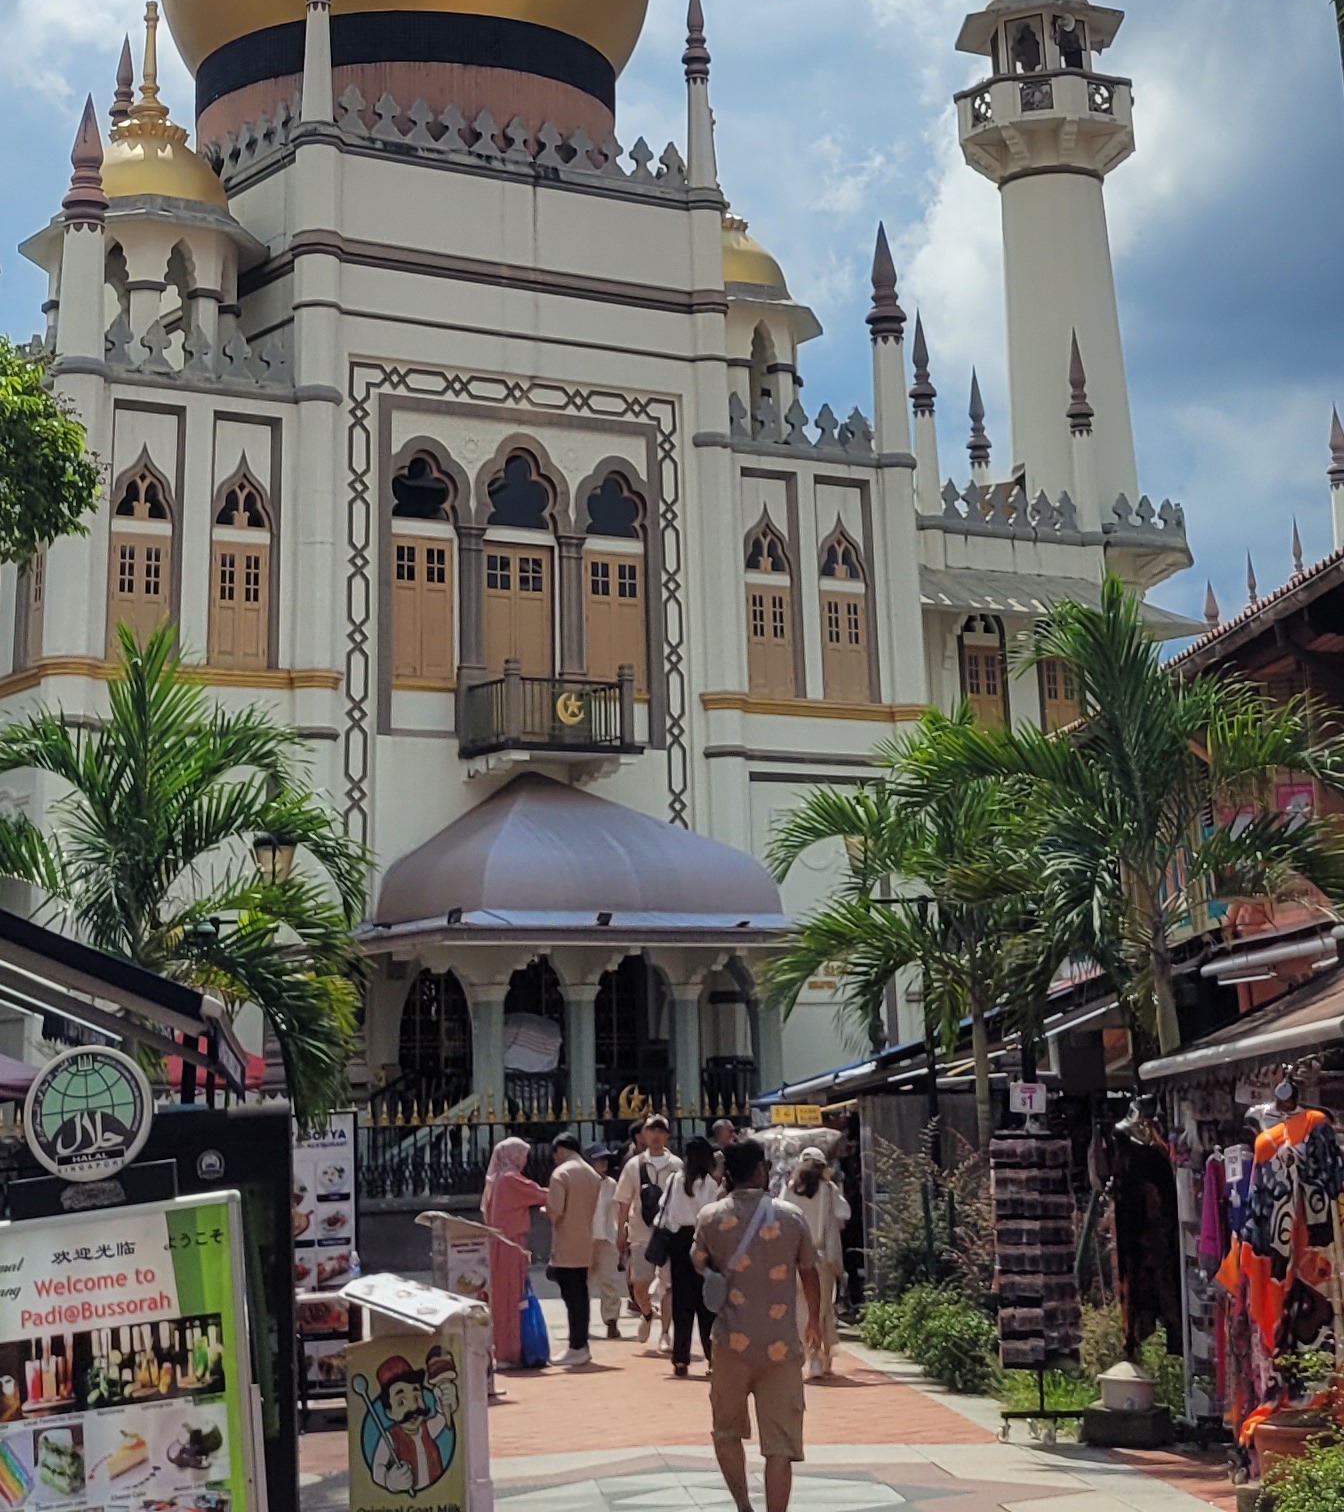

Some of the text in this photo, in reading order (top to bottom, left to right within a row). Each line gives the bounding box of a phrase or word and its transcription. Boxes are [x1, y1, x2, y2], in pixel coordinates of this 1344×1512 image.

[56, 1110, 125, 1154] حلال
[72, 1152, 109, 1164] HALAL
[51, 1241, 137, 1265] 欢迎光临
[163, 1228, 224, 1251] ようこそ
[34, 1267, 156, 1298] Welcome to
[20, 1291, 172, 1329] Padi@Bussorah
